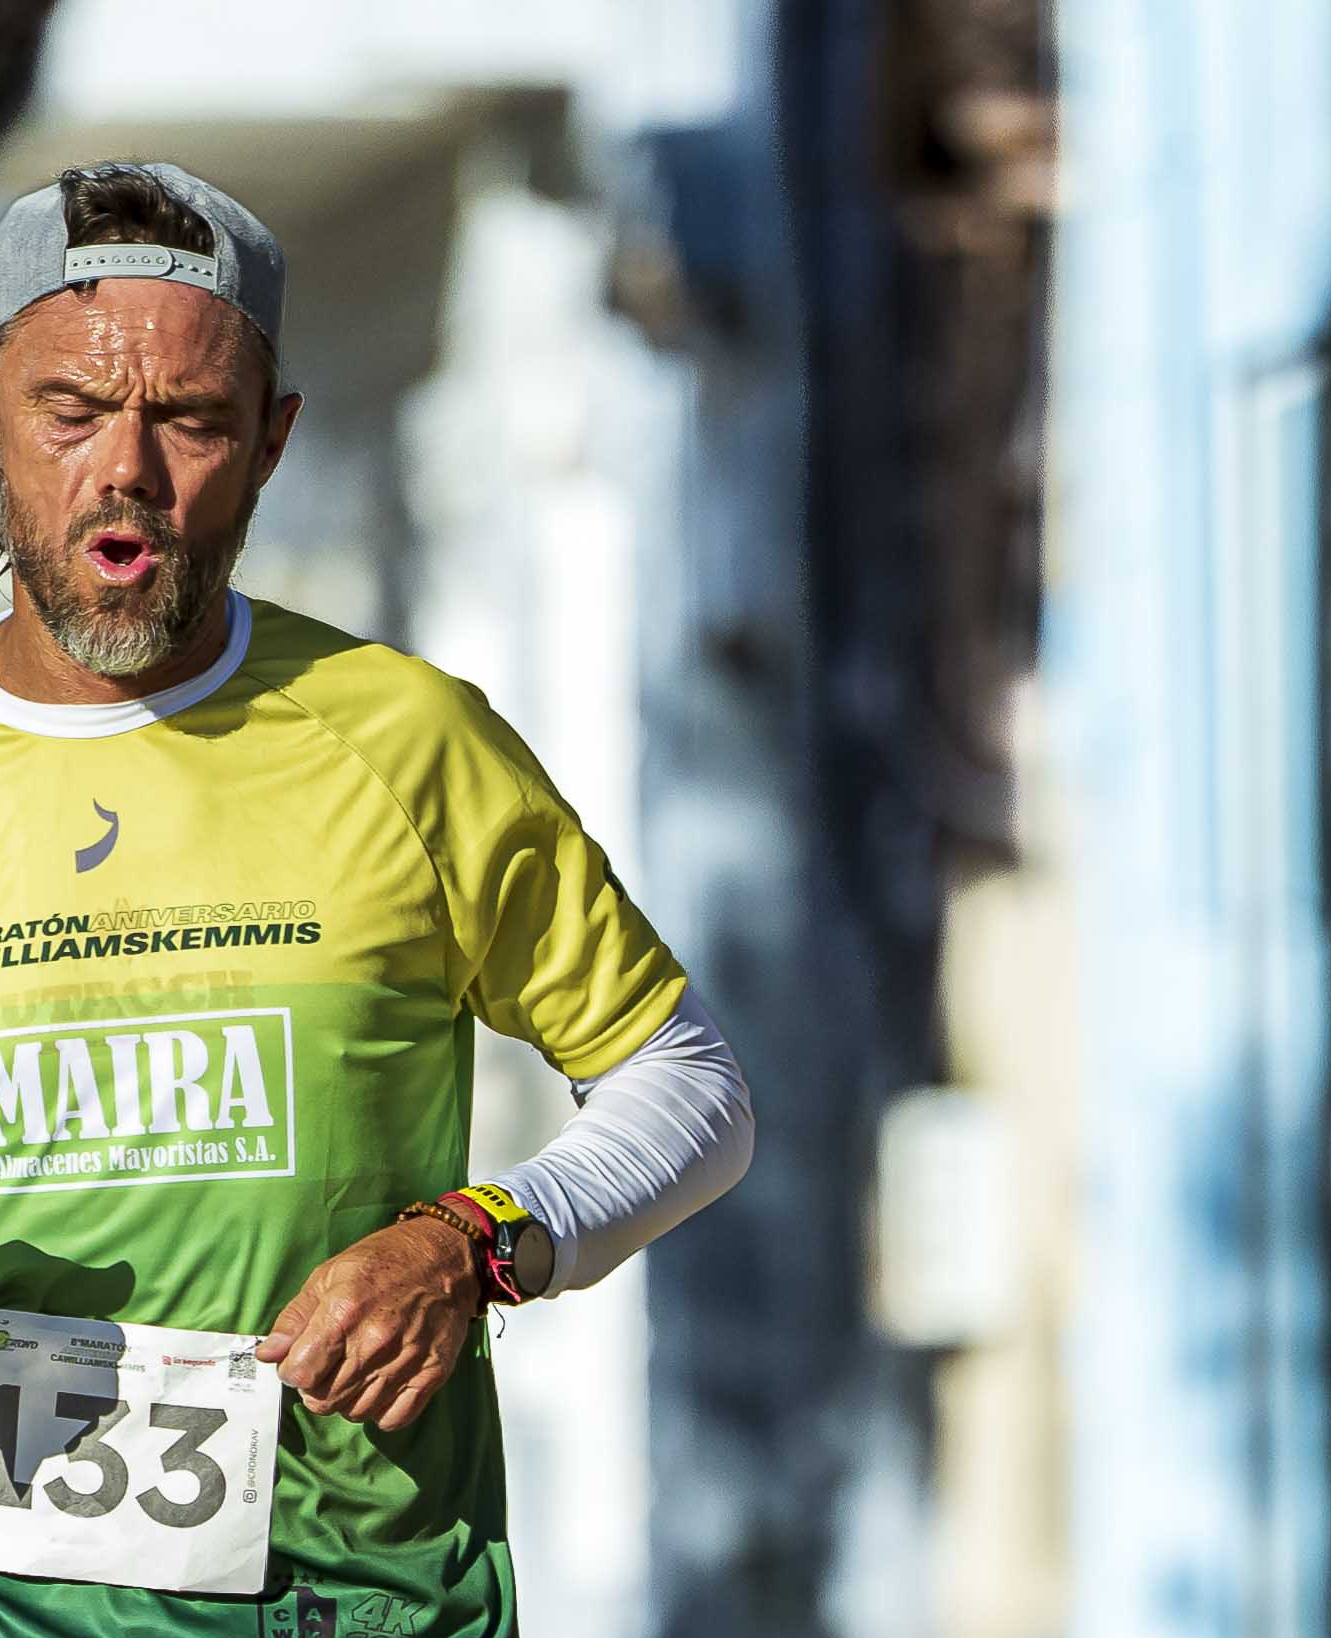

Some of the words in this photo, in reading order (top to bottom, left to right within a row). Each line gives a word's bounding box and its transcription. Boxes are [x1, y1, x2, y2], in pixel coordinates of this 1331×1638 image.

[88, 900, 316, 932] ANIVERSARIO
[108, 1138, 229, 1173] Mayoristas
[235, 1135, 276, 1163] S.A.
[352, 1593, 428, 1637] 4K
